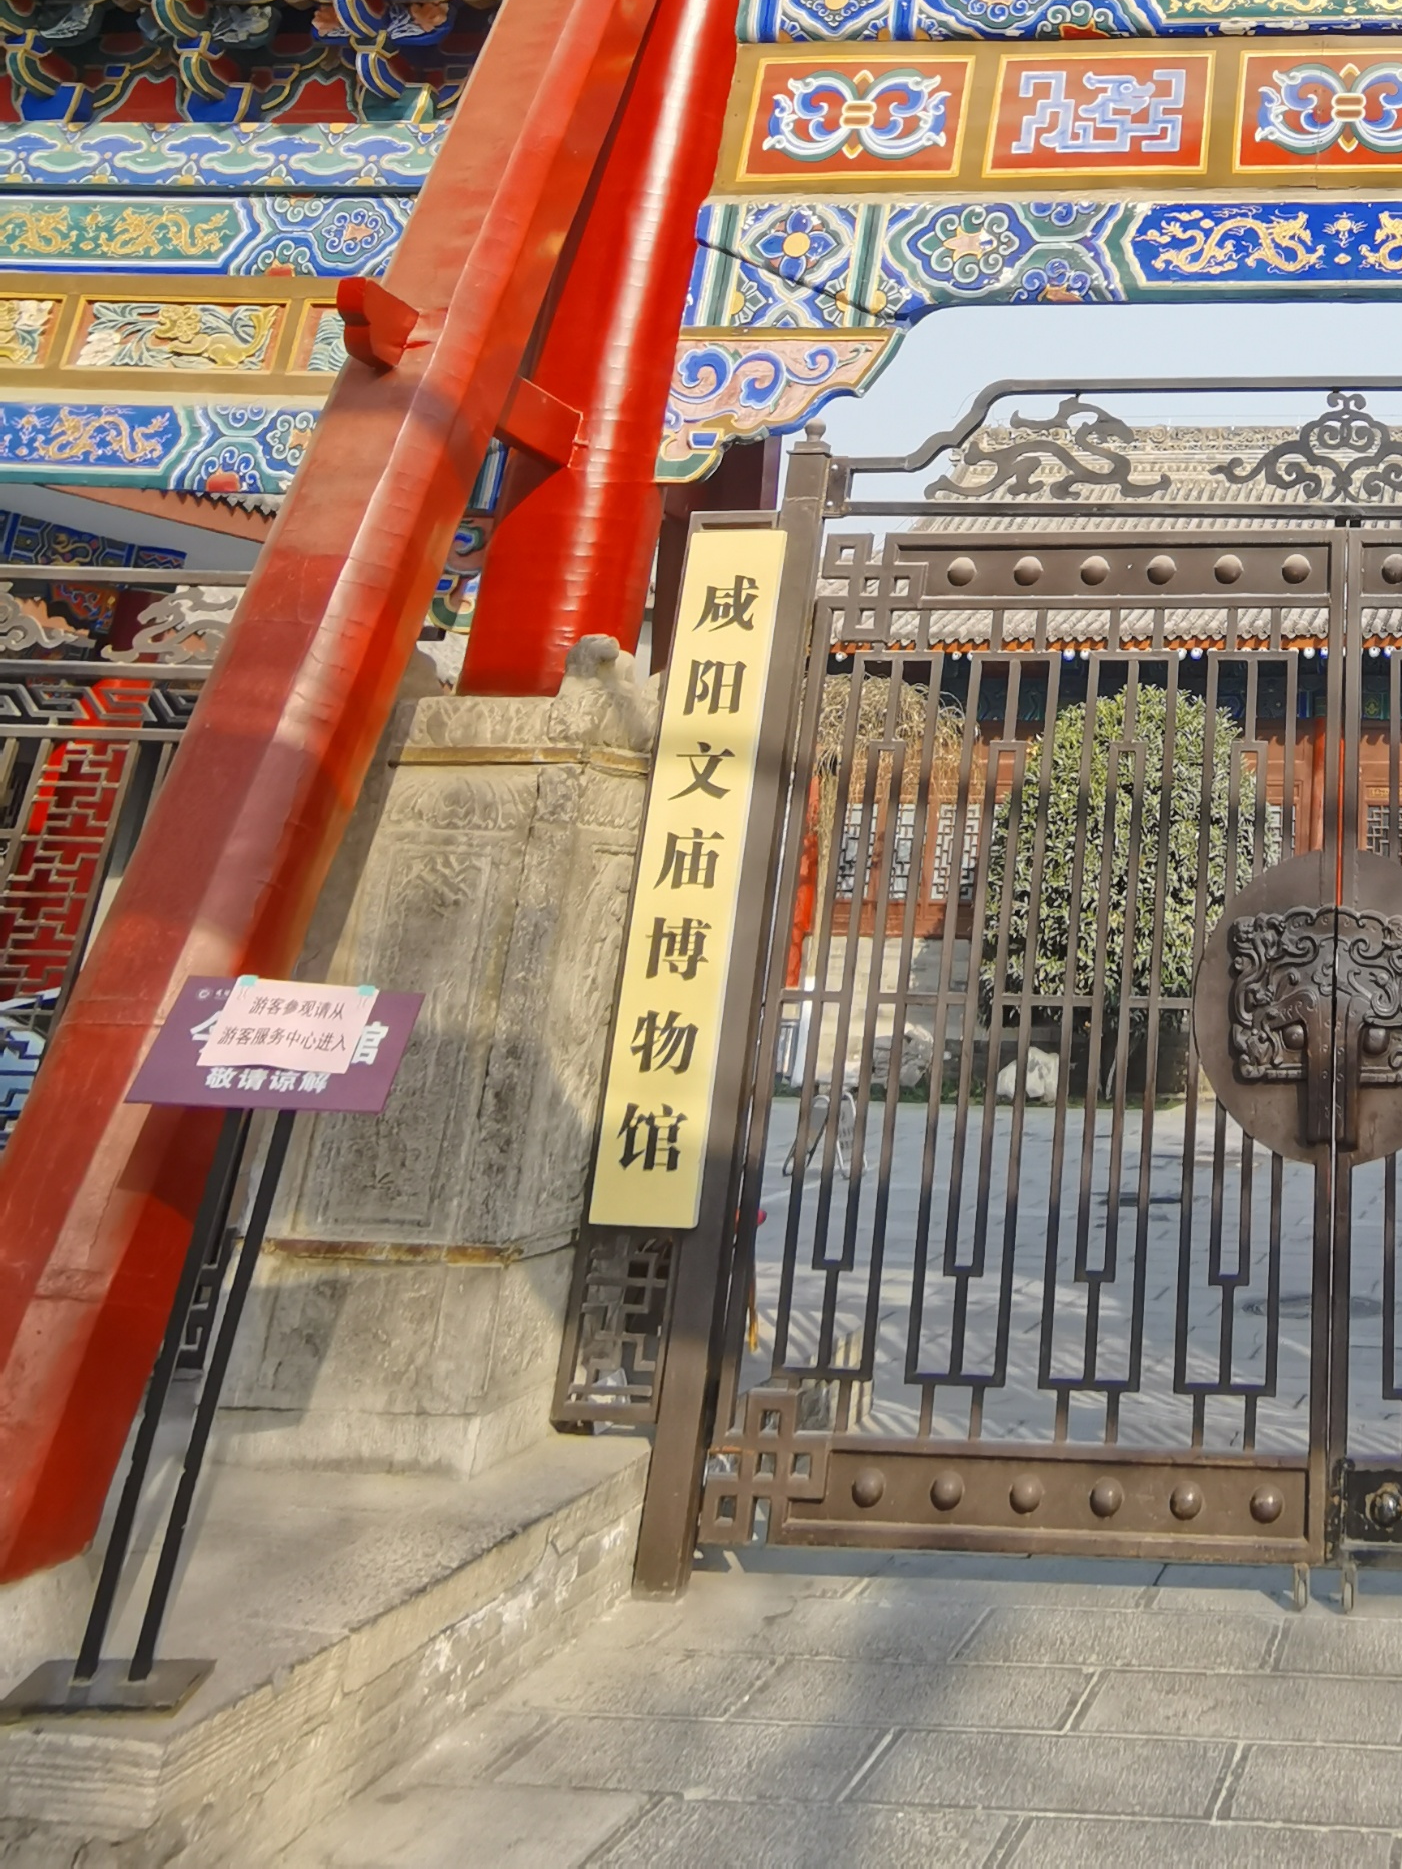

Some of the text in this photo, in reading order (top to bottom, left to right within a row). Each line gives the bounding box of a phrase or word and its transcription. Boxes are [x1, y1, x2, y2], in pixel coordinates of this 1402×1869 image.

[616, 574, 757, 1174] 咸阳文庙博物馆
[218, 1026, 346, 1053] 游客服务中心进入
[204, 1067, 331, 1095] 敬请谅解
